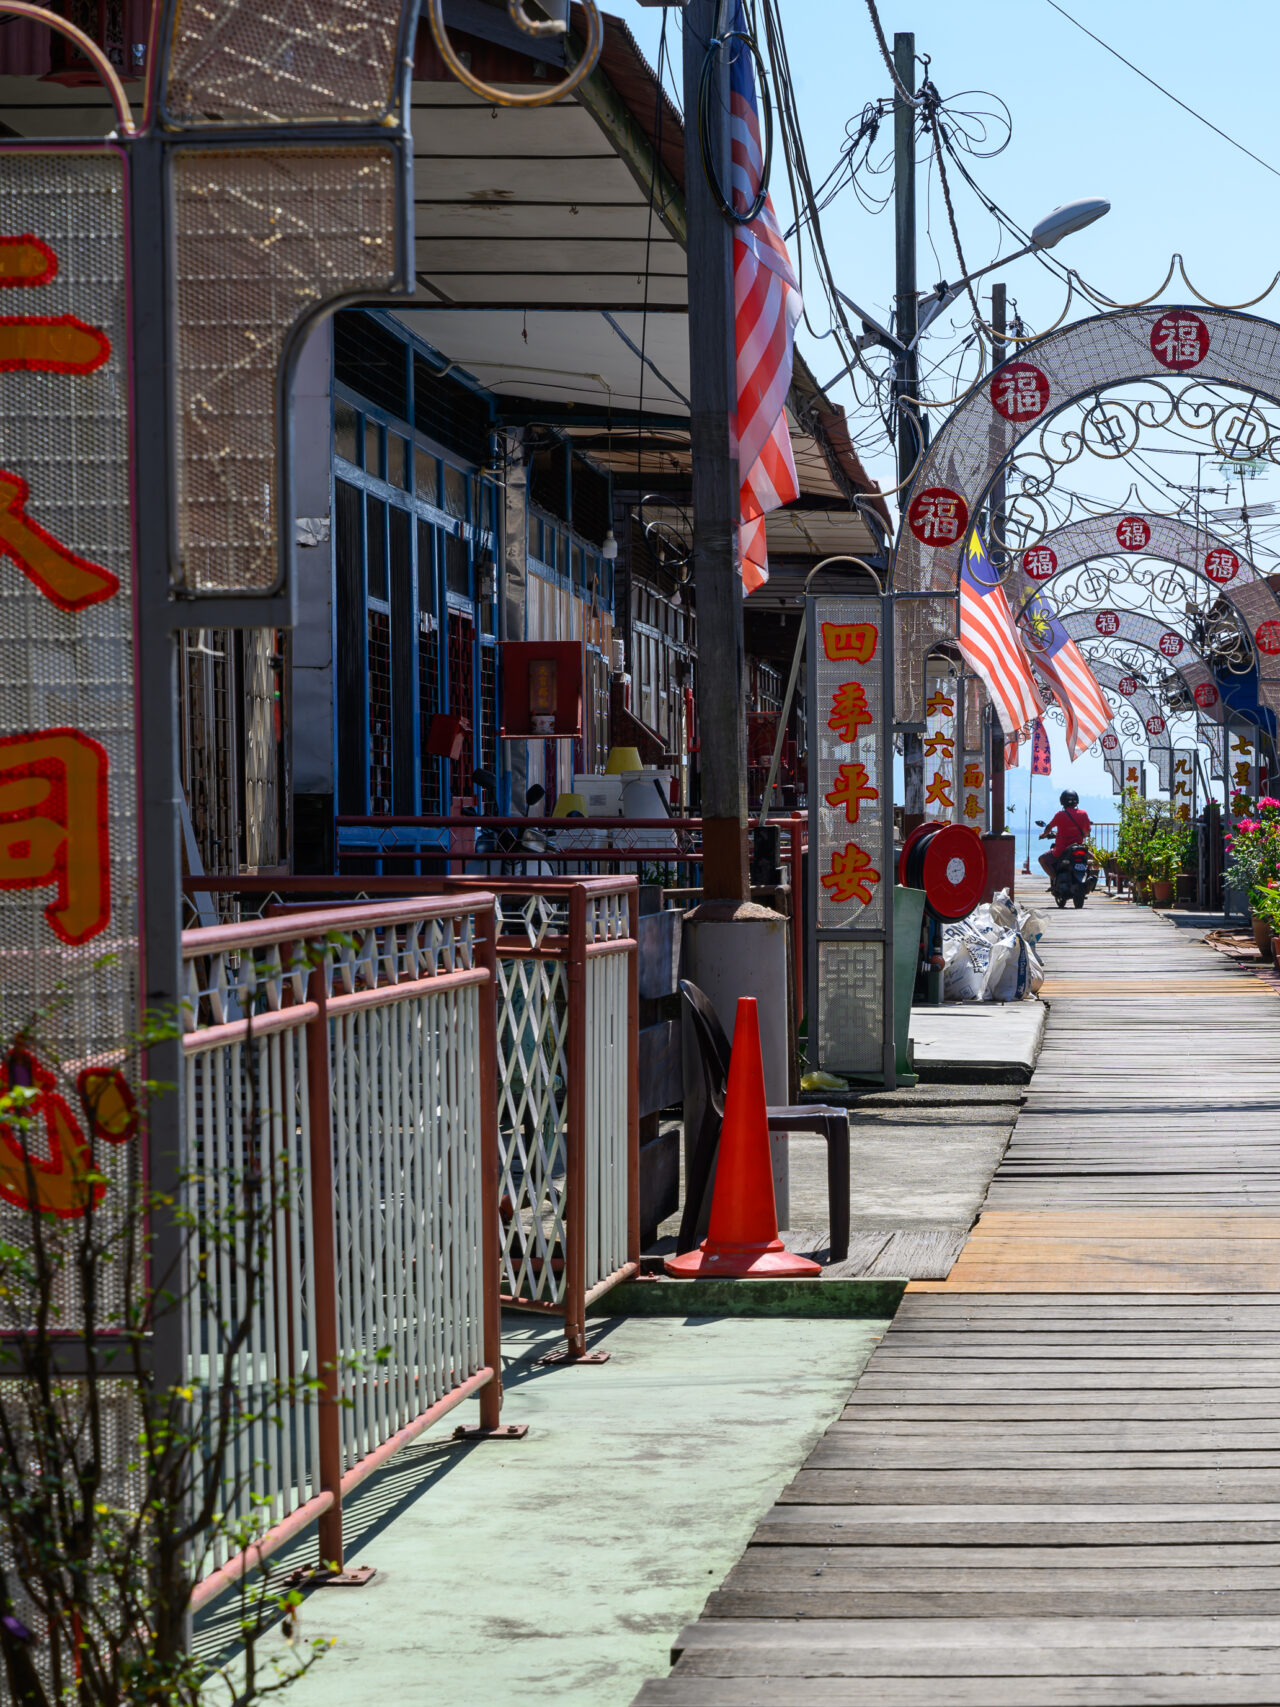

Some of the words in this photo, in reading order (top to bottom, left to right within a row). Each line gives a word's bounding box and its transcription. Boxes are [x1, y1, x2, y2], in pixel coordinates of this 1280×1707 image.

[1153, 318, 1202, 364] 福
[994, 369, 1042, 417] 福
[912, 494, 961, 542] 福
[1119, 520, 1146, 547] 福
[1024, 550, 1054, 577] 福
[1208, 551, 1235, 579] 福
[1097, 614, 1117, 633] 福
[1160, 635, 1181, 654] 福
[1197, 686, 1216, 705] 福
[821, 622, 881, 905] 四季平安
[924, 691, 955, 826] 六六大
[963, 763, 985, 832] 面春
